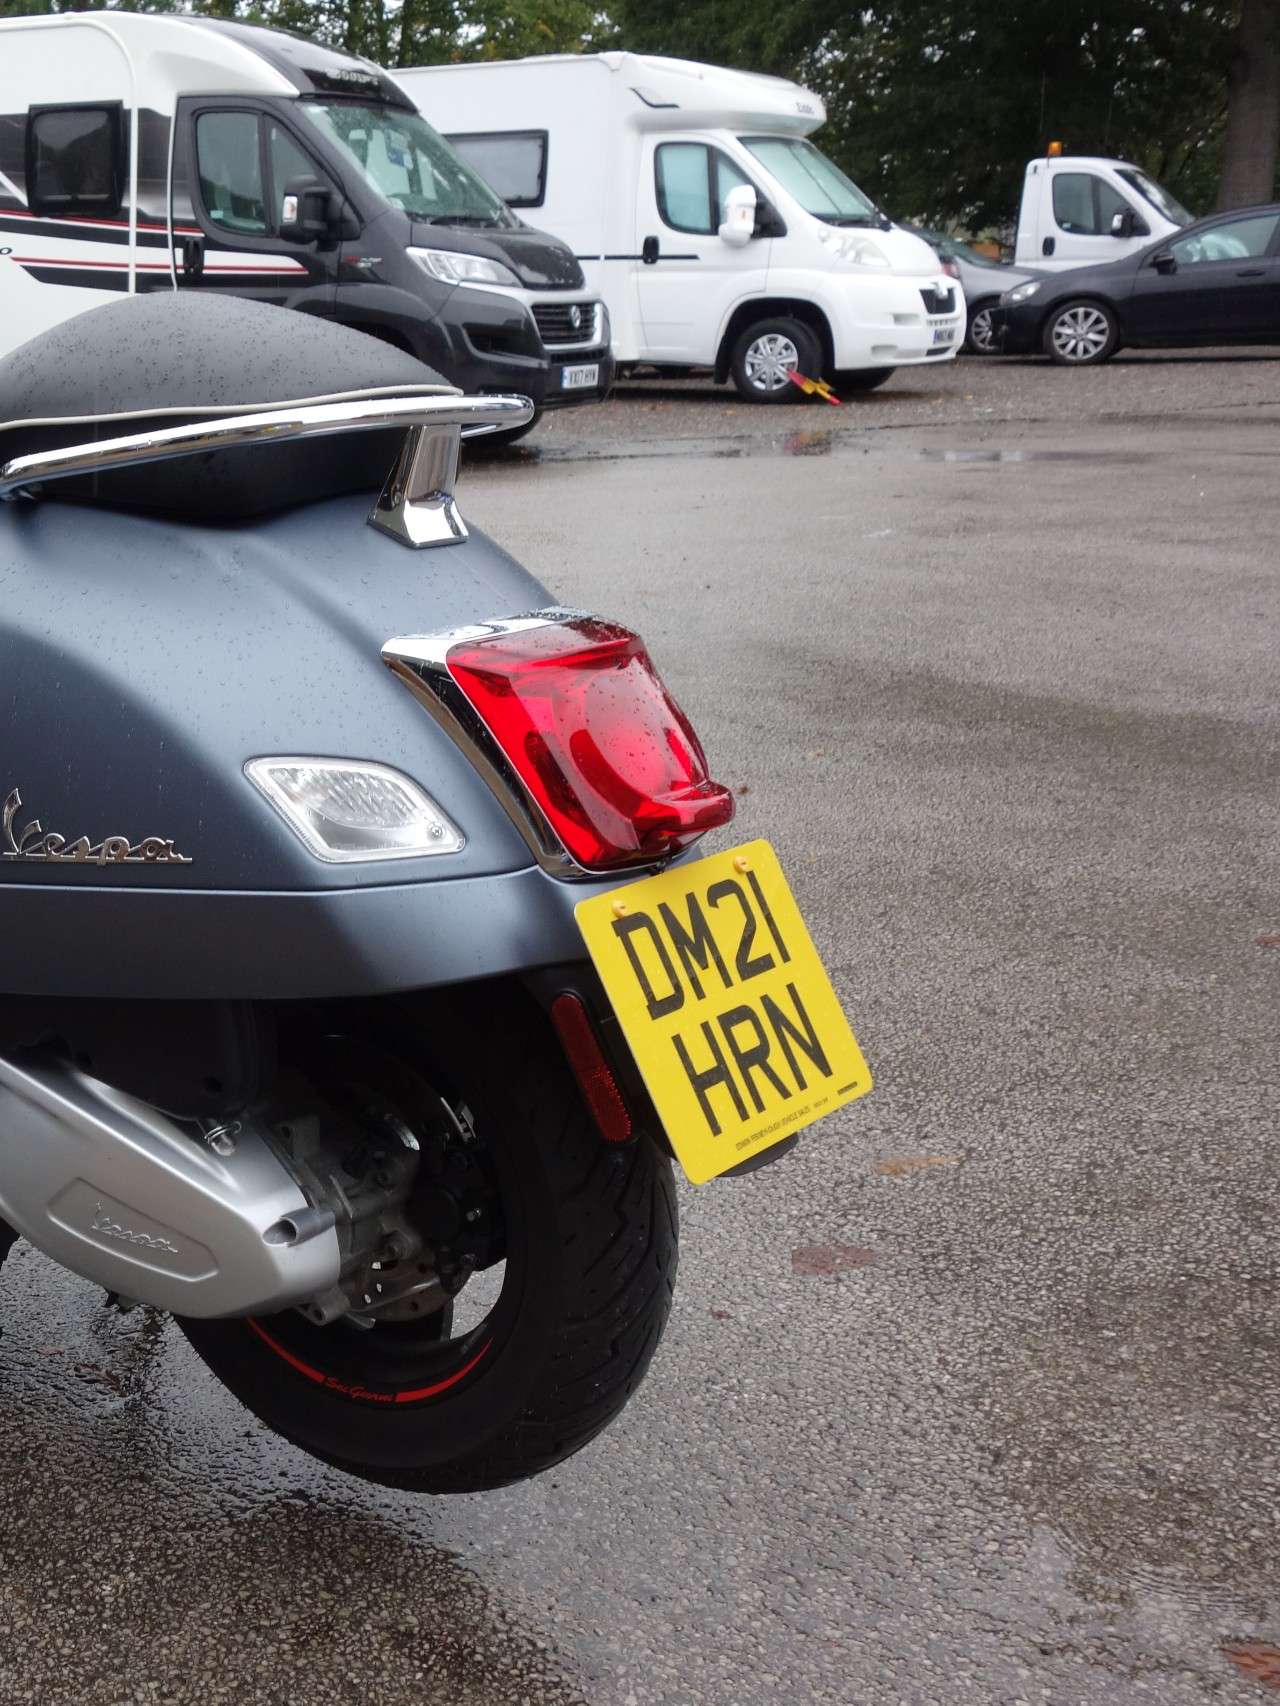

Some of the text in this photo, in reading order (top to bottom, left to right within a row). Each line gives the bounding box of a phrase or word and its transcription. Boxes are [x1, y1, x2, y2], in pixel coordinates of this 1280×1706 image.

[1, 788, 192, 865] Vespa
[611, 870, 791, 1021] DM21
[672, 982, 833, 1137] HRN
[91, 1200, 179, 1254] Vespa
